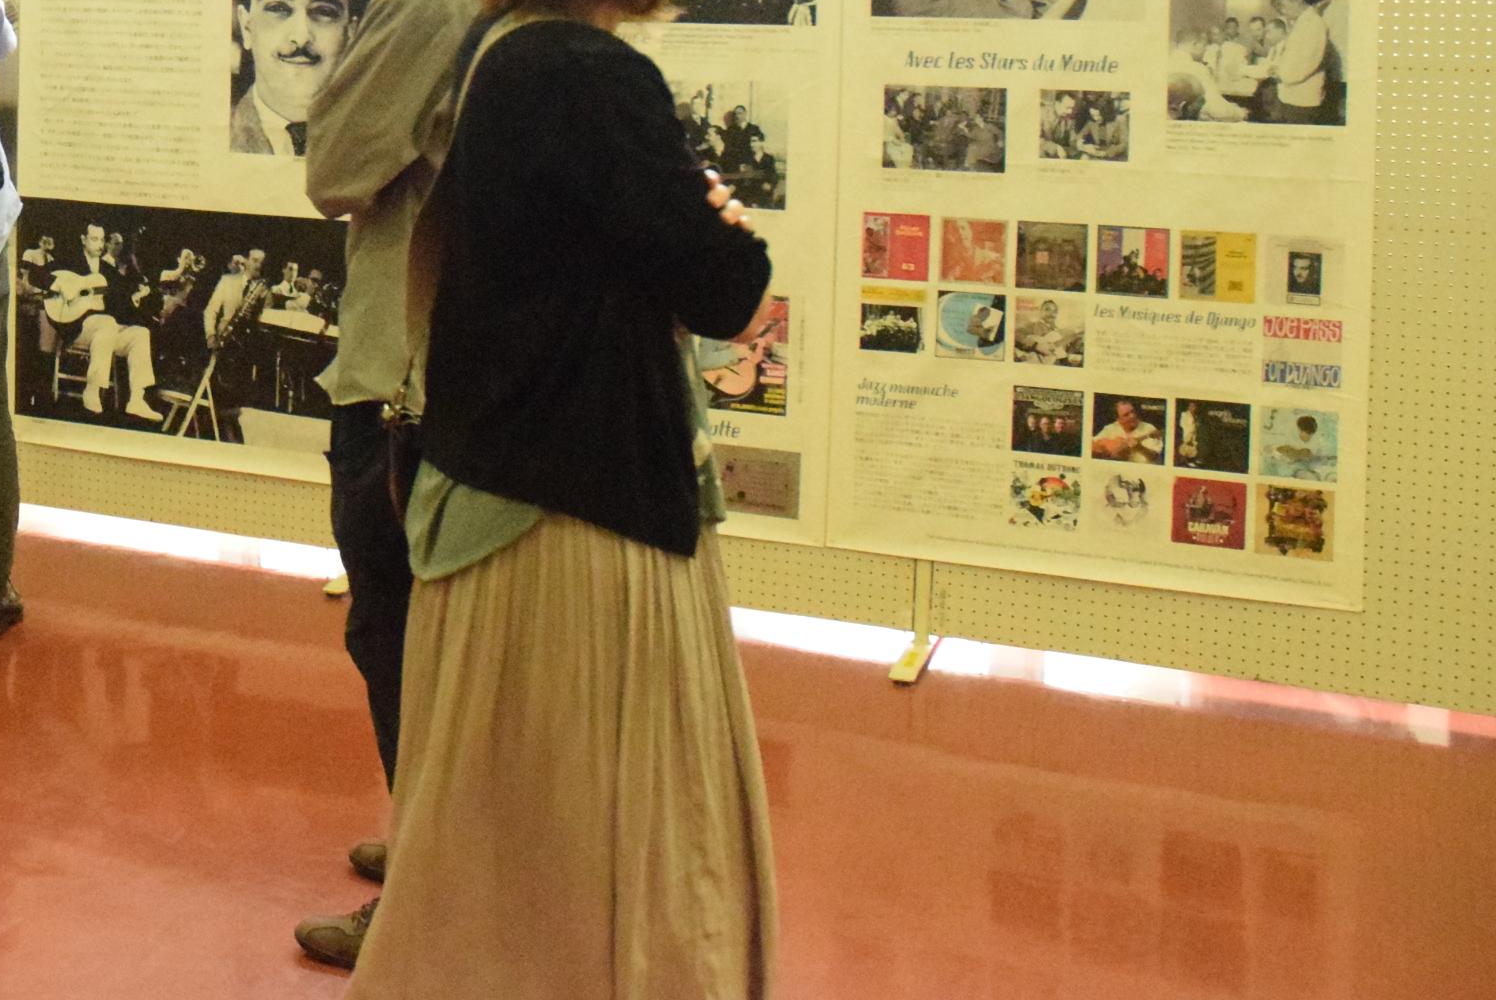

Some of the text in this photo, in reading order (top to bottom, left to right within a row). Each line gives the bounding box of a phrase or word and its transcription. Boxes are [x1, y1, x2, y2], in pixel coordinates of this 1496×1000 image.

[905, 50, 942, 69] Avec
[979, 51, 1028, 71] Stars
[1032, 53, 1054, 71] du
[1059, 54, 1120, 74] Monde
[1119, 306, 1183, 326] Musiques
[1185, 310, 1204, 326] de
[1205, 311, 1257, 331] Django
[1299, 318, 1341, 343] PASS
[857, 377, 887, 396] Jazz
[1286, 363, 1342, 388] DJANGO
[855, 393, 917, 410] moderne
